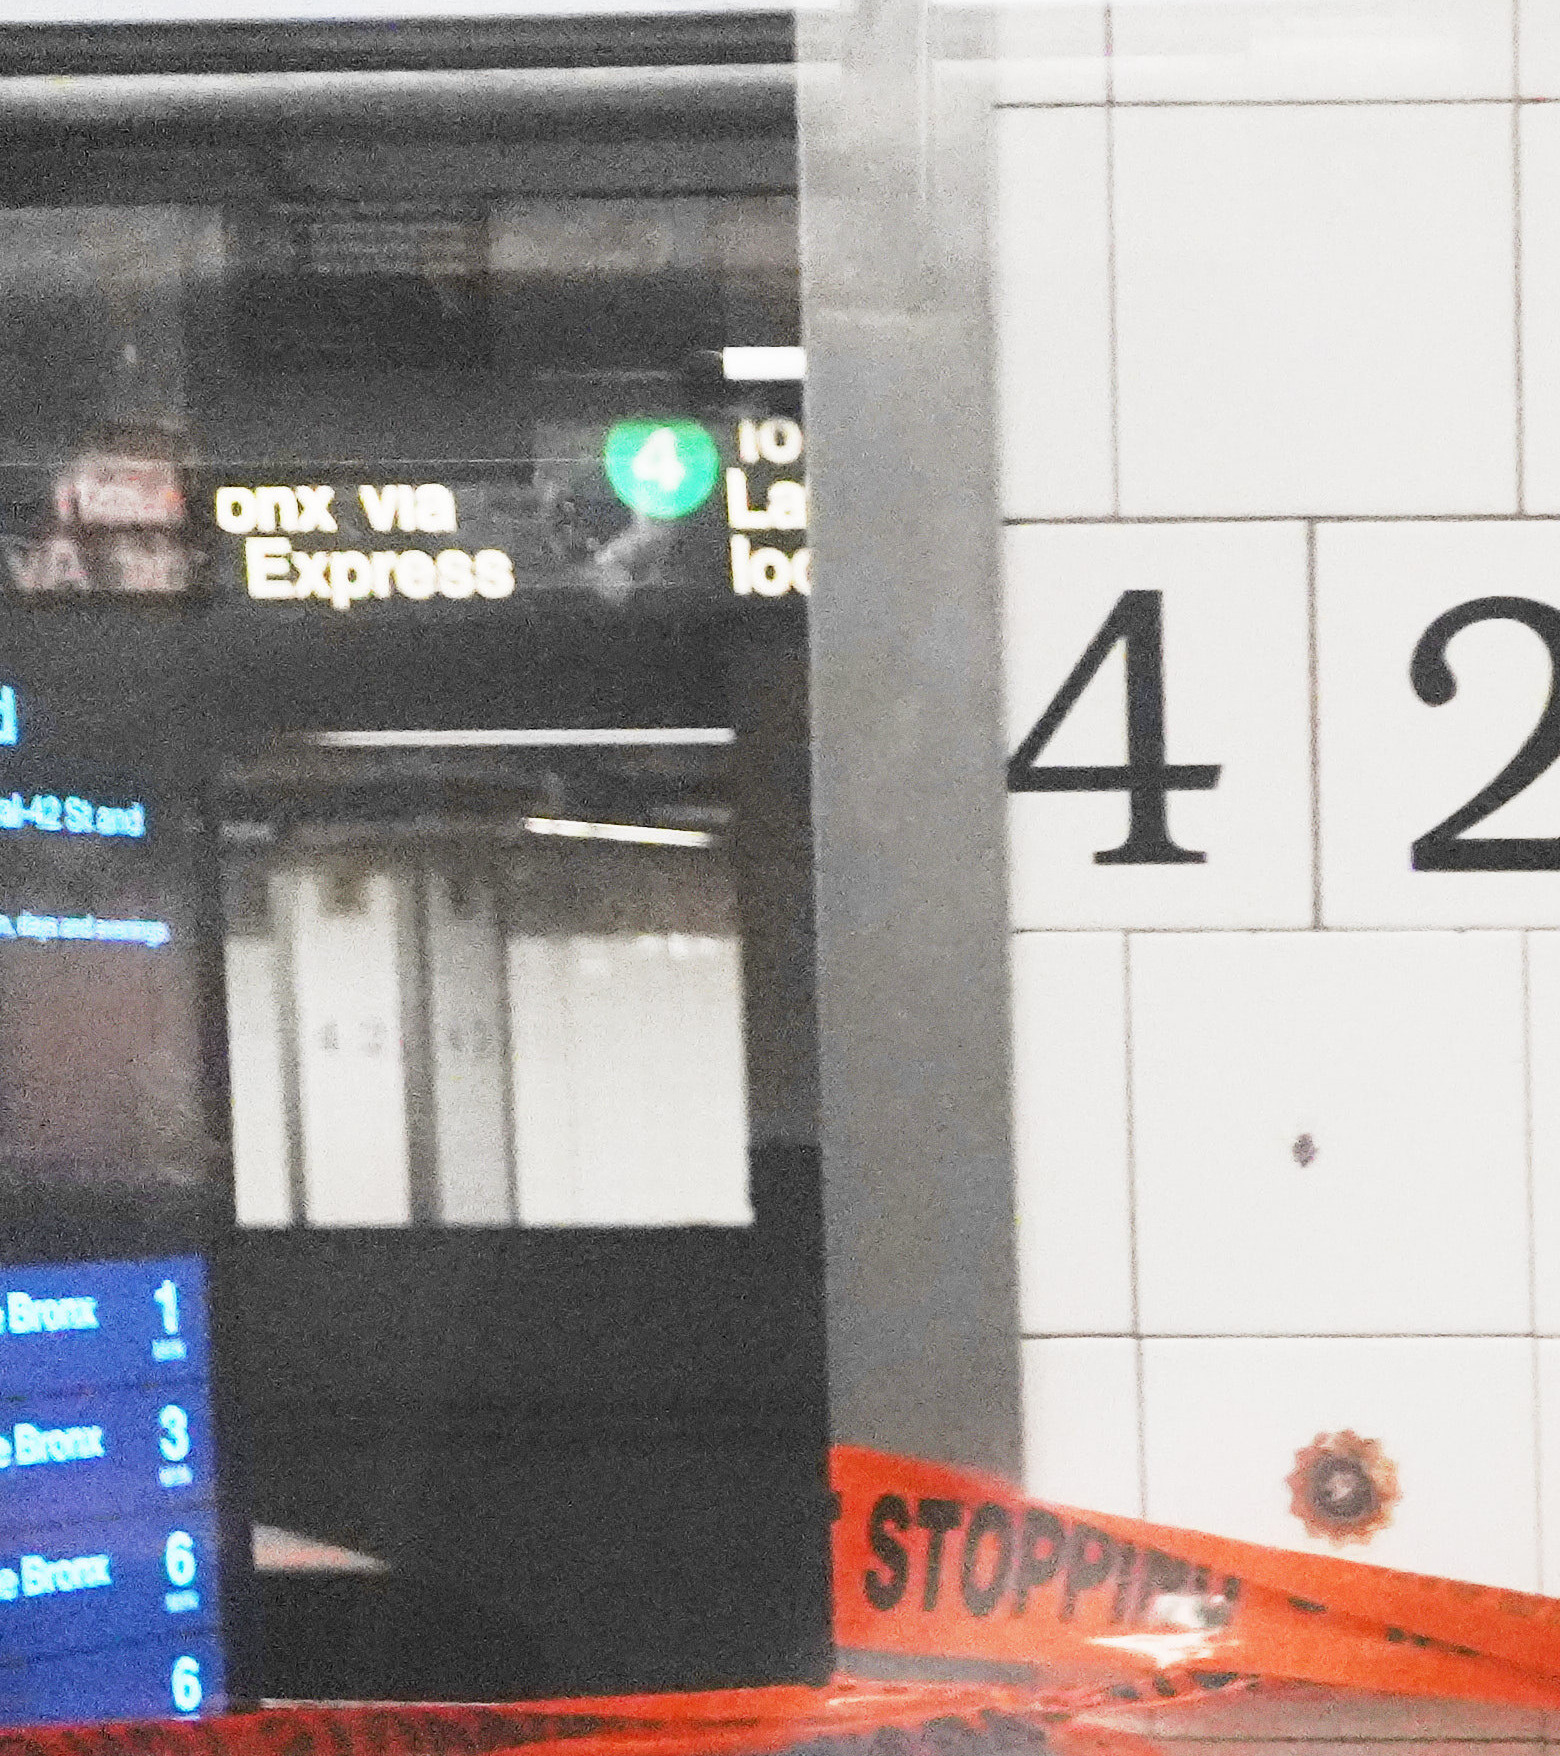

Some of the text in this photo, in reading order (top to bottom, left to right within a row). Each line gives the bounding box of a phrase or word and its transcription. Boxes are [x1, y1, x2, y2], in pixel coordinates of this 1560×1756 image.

[628, 424, 684, 492] 4
[358, 482, 457, 533] via
[245, 536, 516, 610] Express
[6, 1290, 100, 1335] Bronx
[153, 1278, 180, 1336] 1
[13, 1422, 106, 1467] Bronx
[158, 1403, 191, 1462] 3
[20, 1553, 112, 1598] Bronx
[165, 1529, 197, 1587] 6
[170, 1654, 203, 1712] 6
